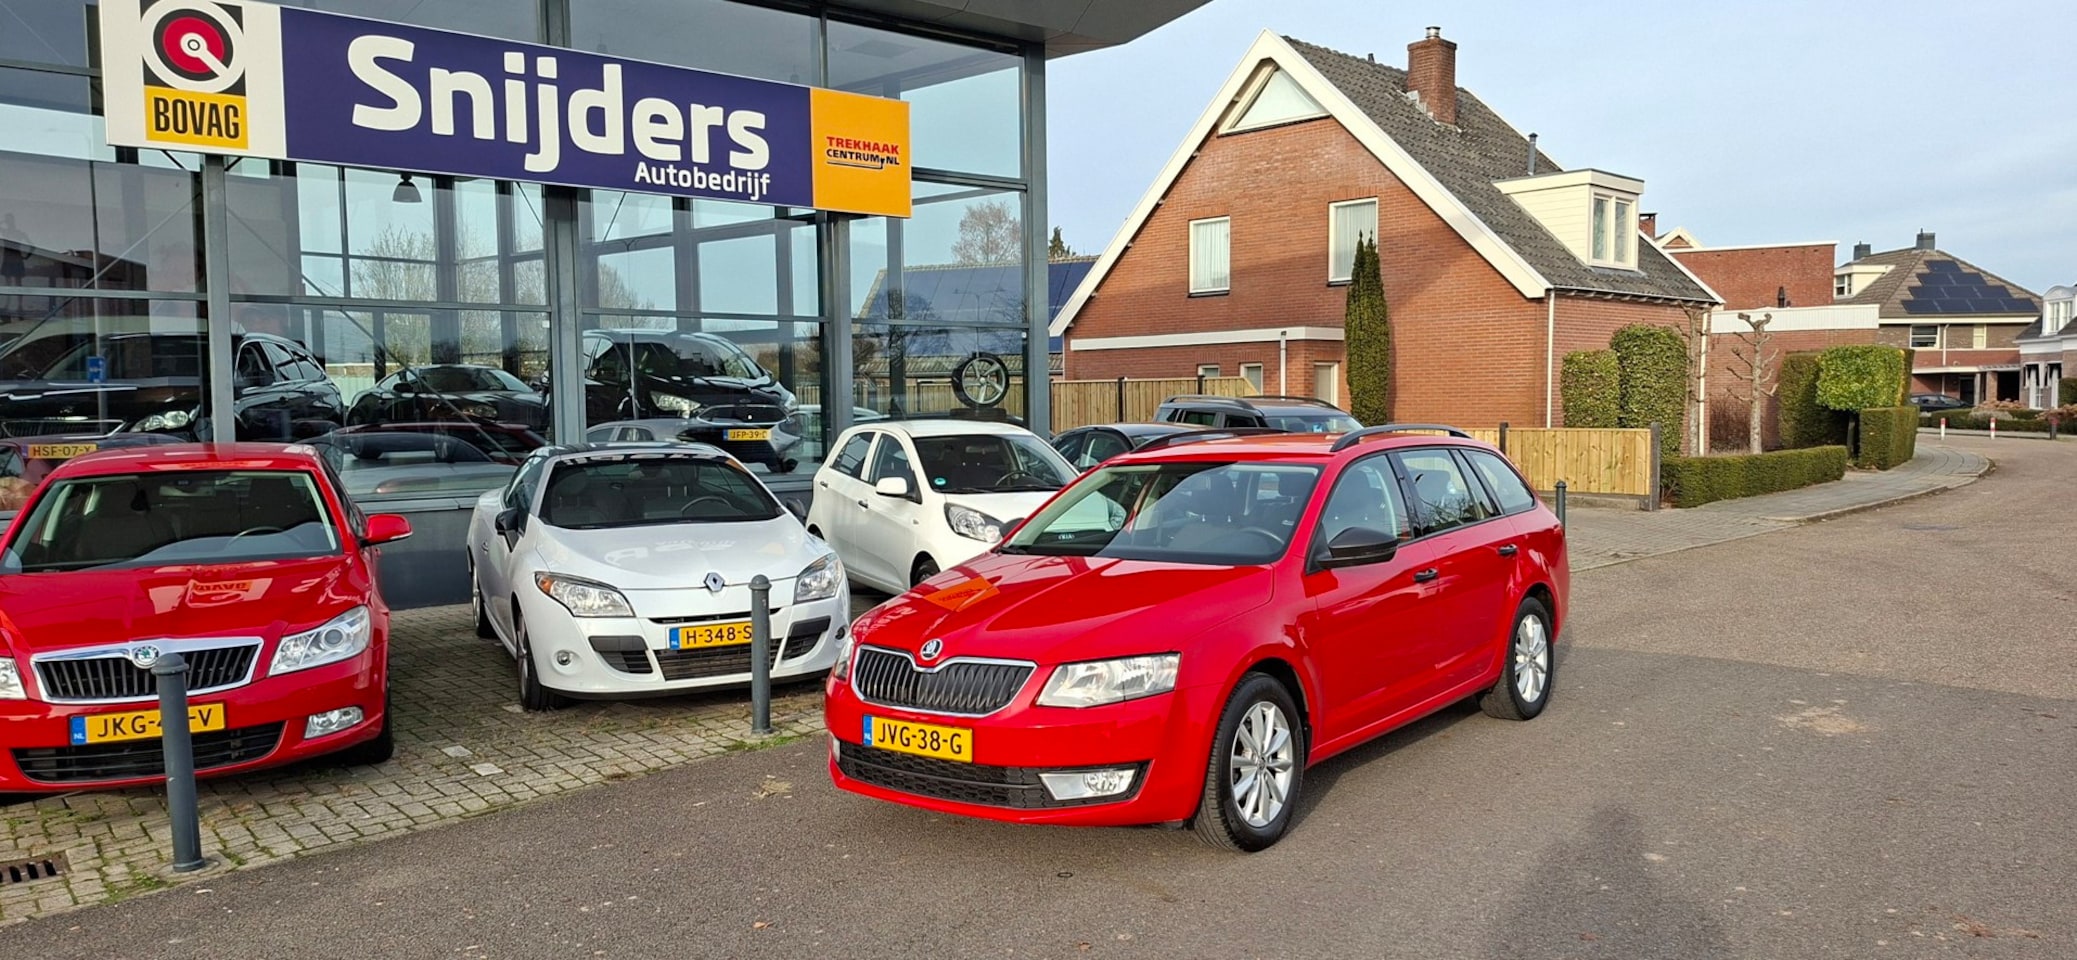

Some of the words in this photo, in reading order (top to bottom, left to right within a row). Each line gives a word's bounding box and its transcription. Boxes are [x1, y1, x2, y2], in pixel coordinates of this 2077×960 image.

[153, 97, 240, 139] BOVAG
[347, 35, 770, 173] Snijders
[826, 136, 899, 155] TREKHAAK
[634, 162, 771, 201] Autobedrijf
[878, 723, 962, 755] JVG-38-G
